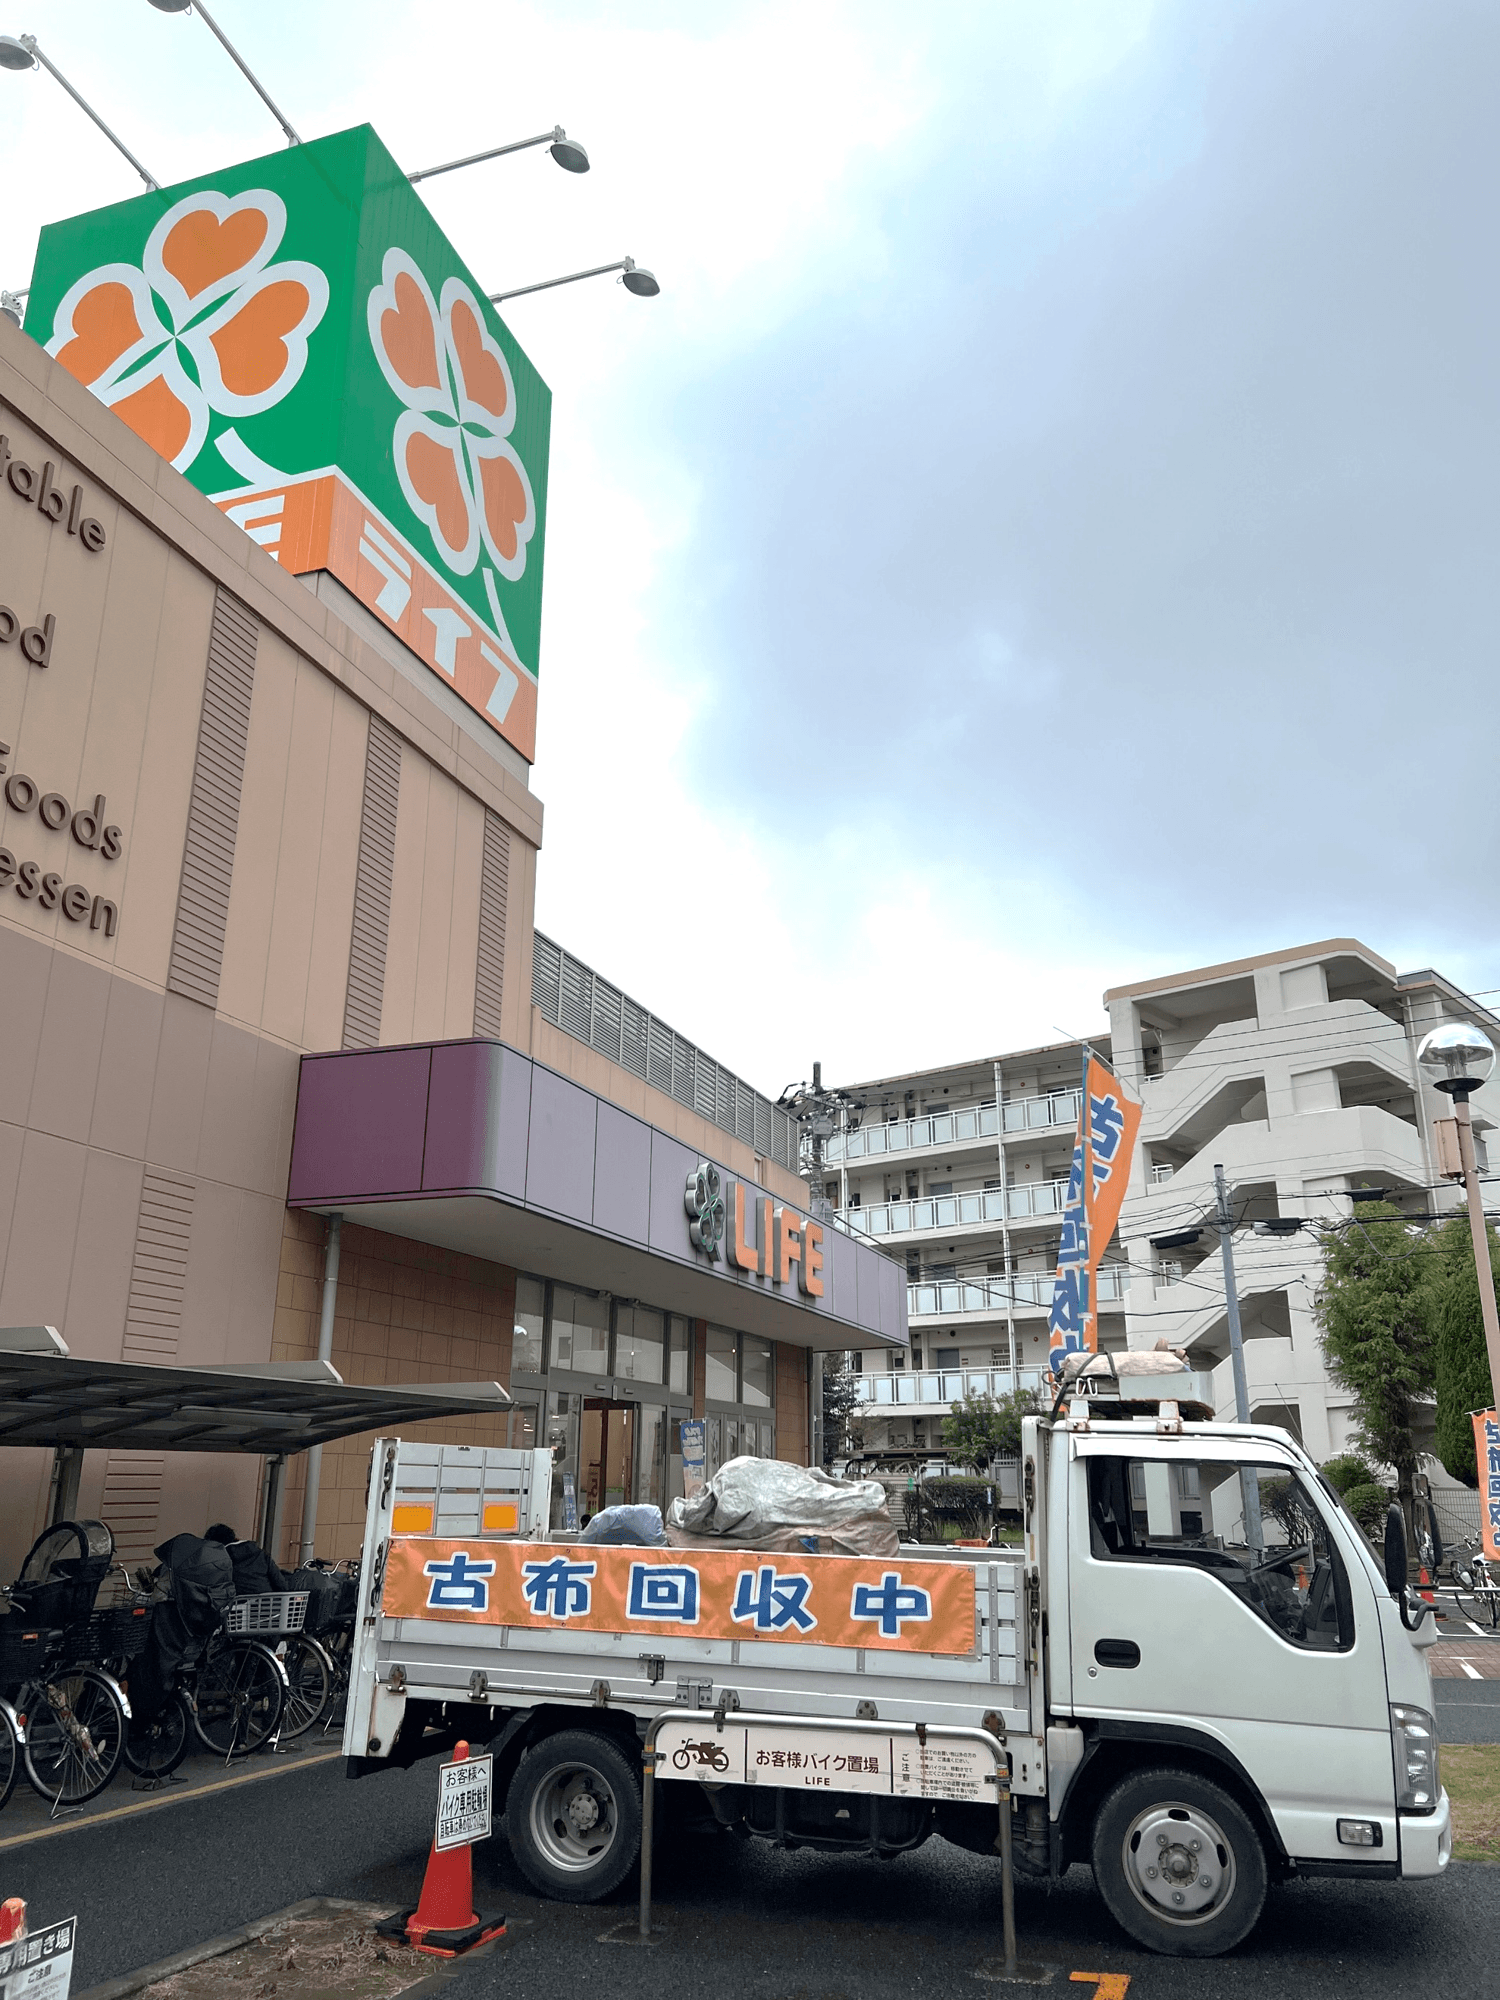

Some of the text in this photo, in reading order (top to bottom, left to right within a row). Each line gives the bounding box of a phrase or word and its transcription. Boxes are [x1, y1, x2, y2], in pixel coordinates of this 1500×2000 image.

[359, 519, 519, 724] ライフ
[726, 1181, 824, 1298] LIFE
[424, 1552, 931, 1638] 古布回収中
[445, 1766, 487, 1787] お客様へ
[756, 1750, 879, 1774] お客様バイク置場
[805, 1776, 830, 1786] LIFE
